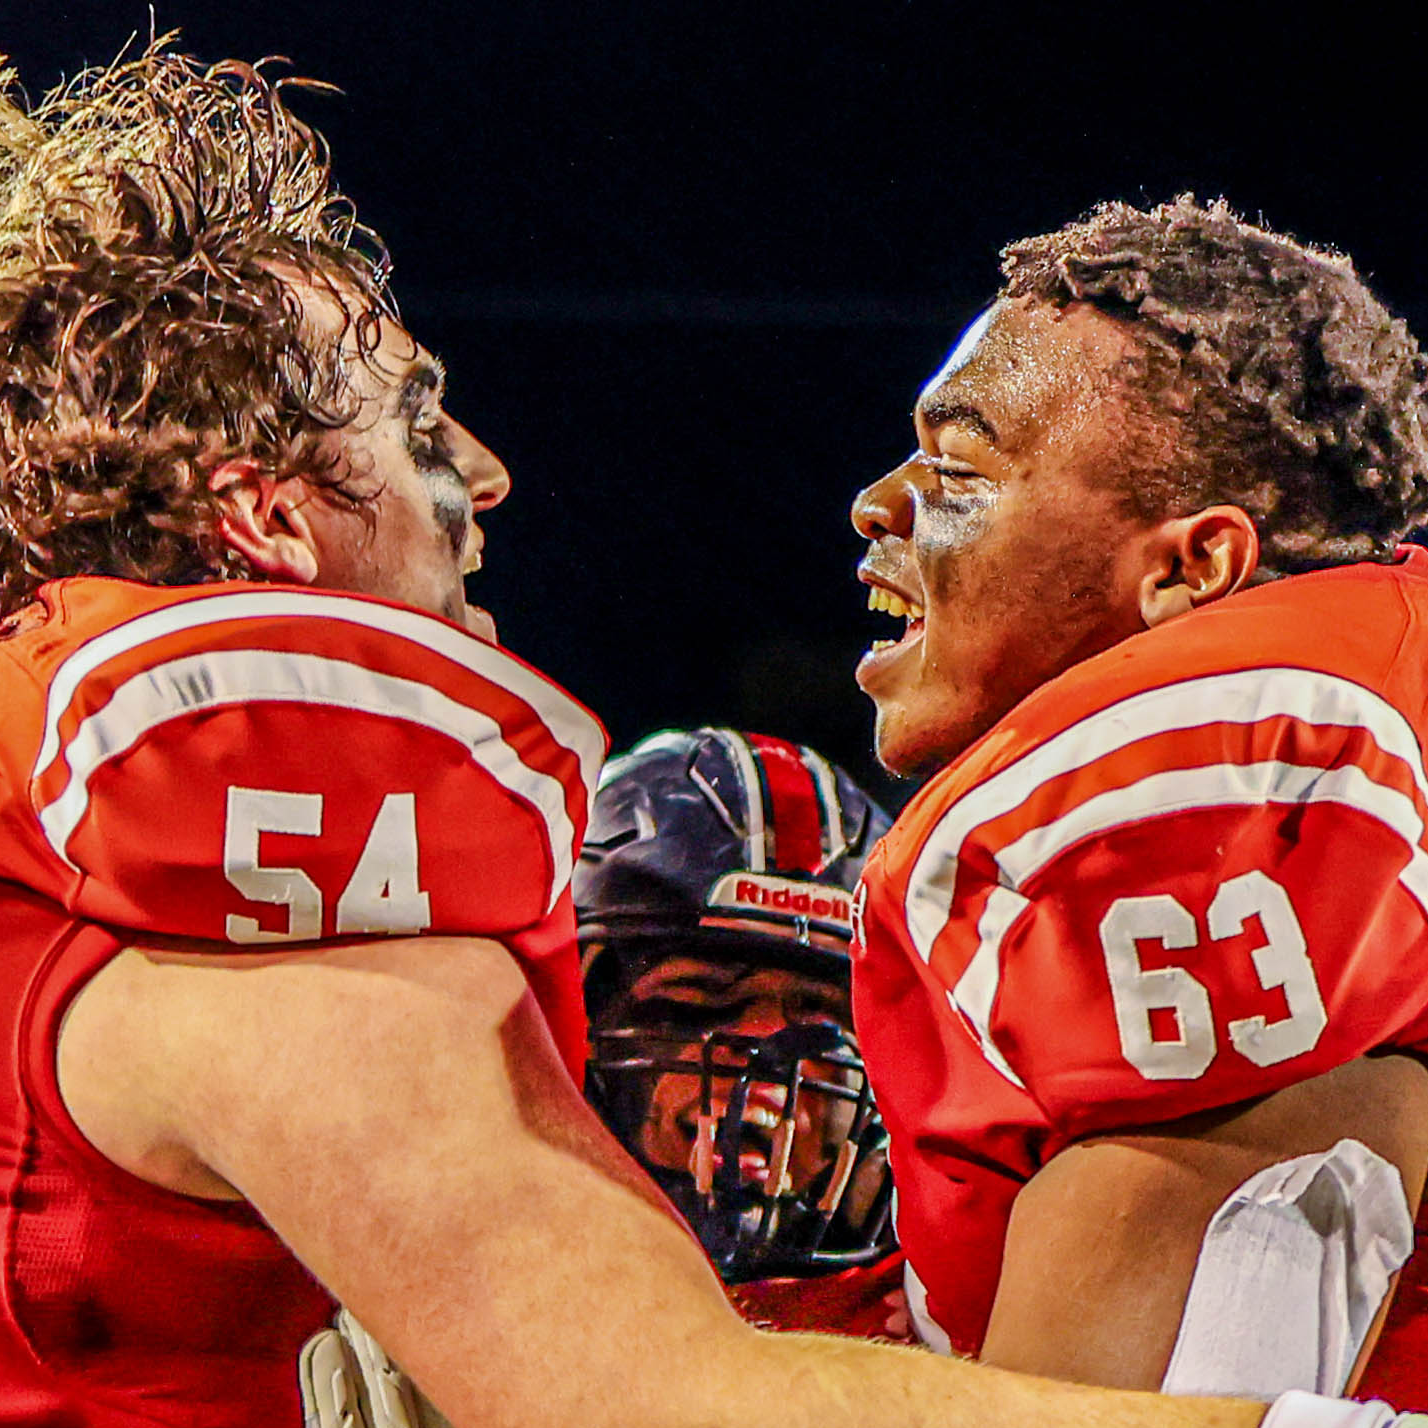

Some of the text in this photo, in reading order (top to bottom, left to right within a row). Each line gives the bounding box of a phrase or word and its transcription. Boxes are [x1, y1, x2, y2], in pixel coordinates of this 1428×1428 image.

[225, 786, 432, 944] 54
[735, 879, 850, 922] Riddell
[1099, 869, 1328, 1080] 63
